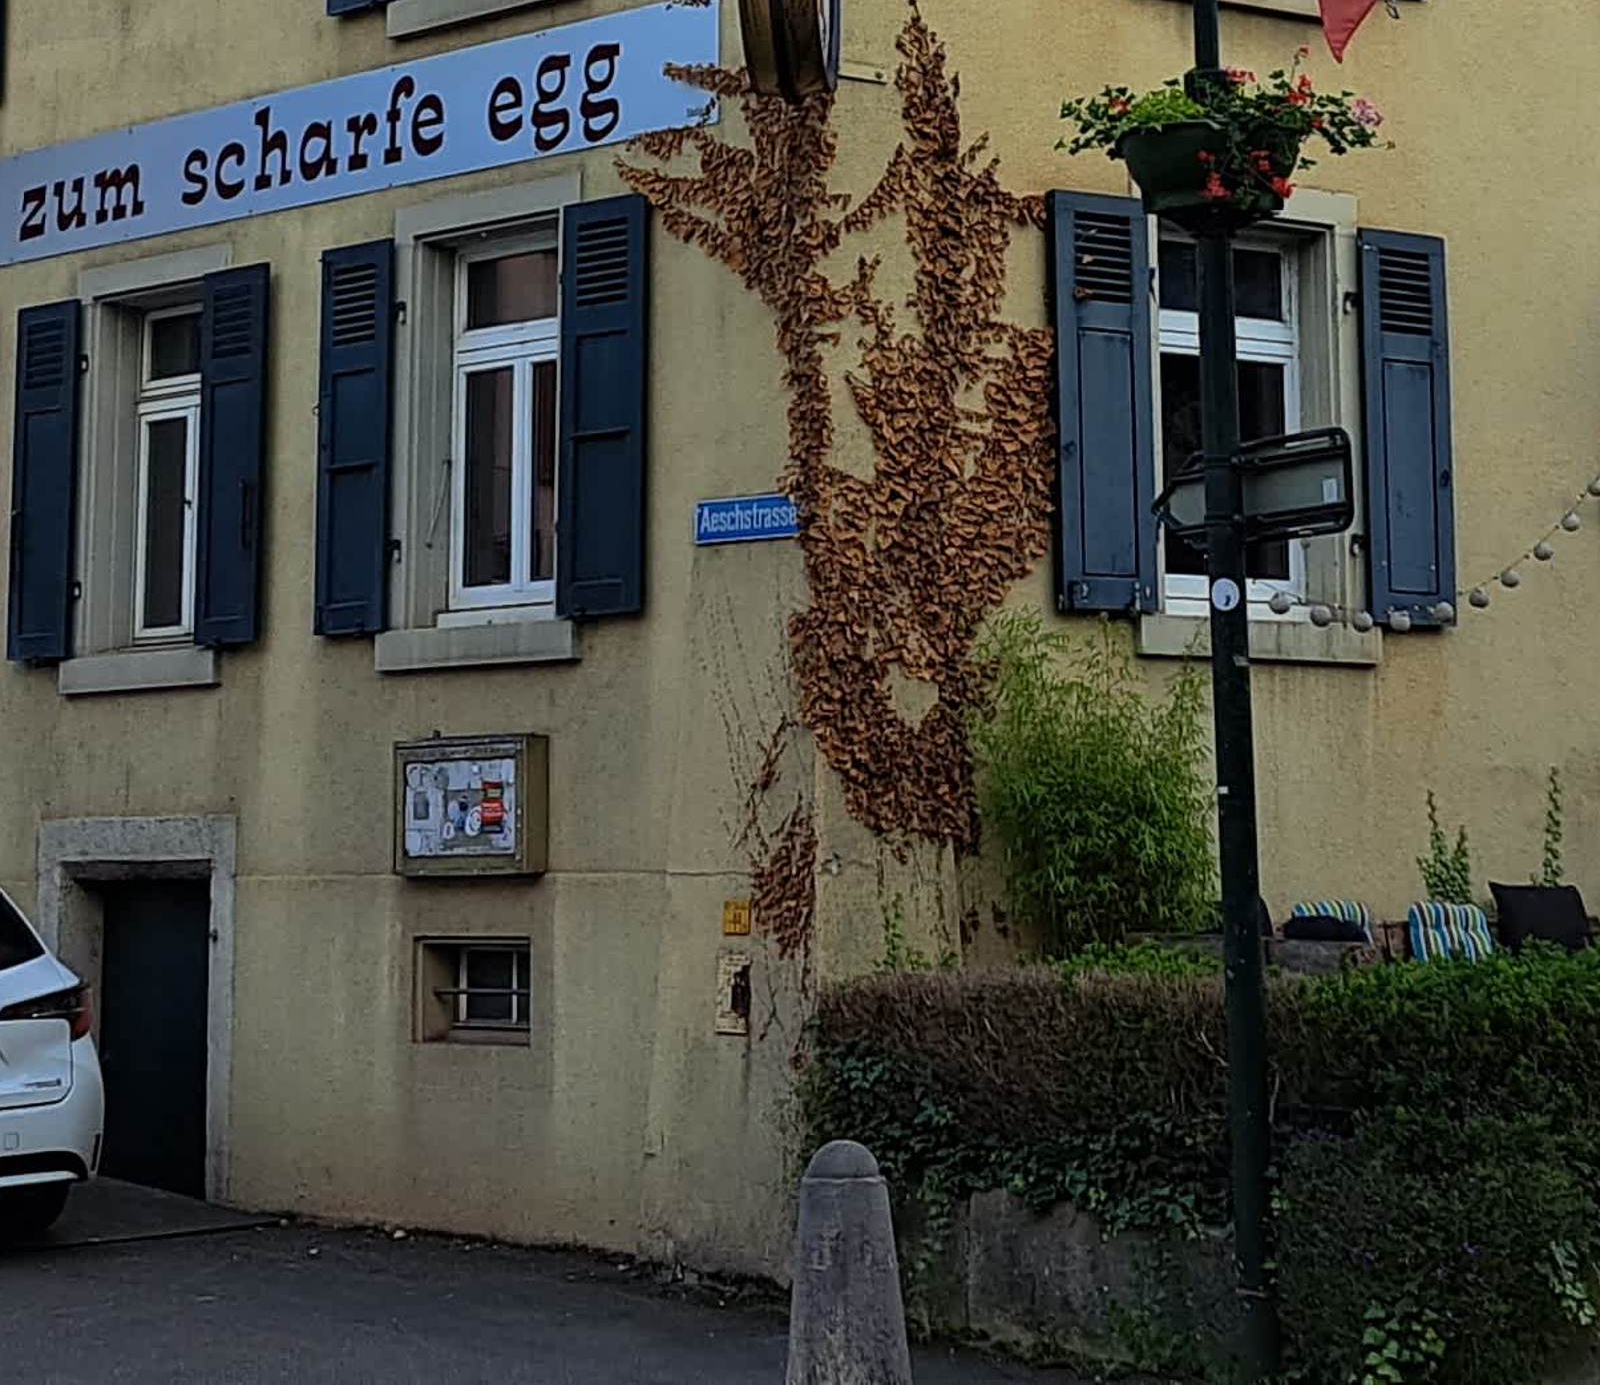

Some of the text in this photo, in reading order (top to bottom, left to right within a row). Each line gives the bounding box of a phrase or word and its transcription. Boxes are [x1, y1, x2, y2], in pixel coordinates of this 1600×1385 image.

[18, 42, 620, 243] zum scharfe egg
[700, 502, 797, 534] Aeschstrasse
